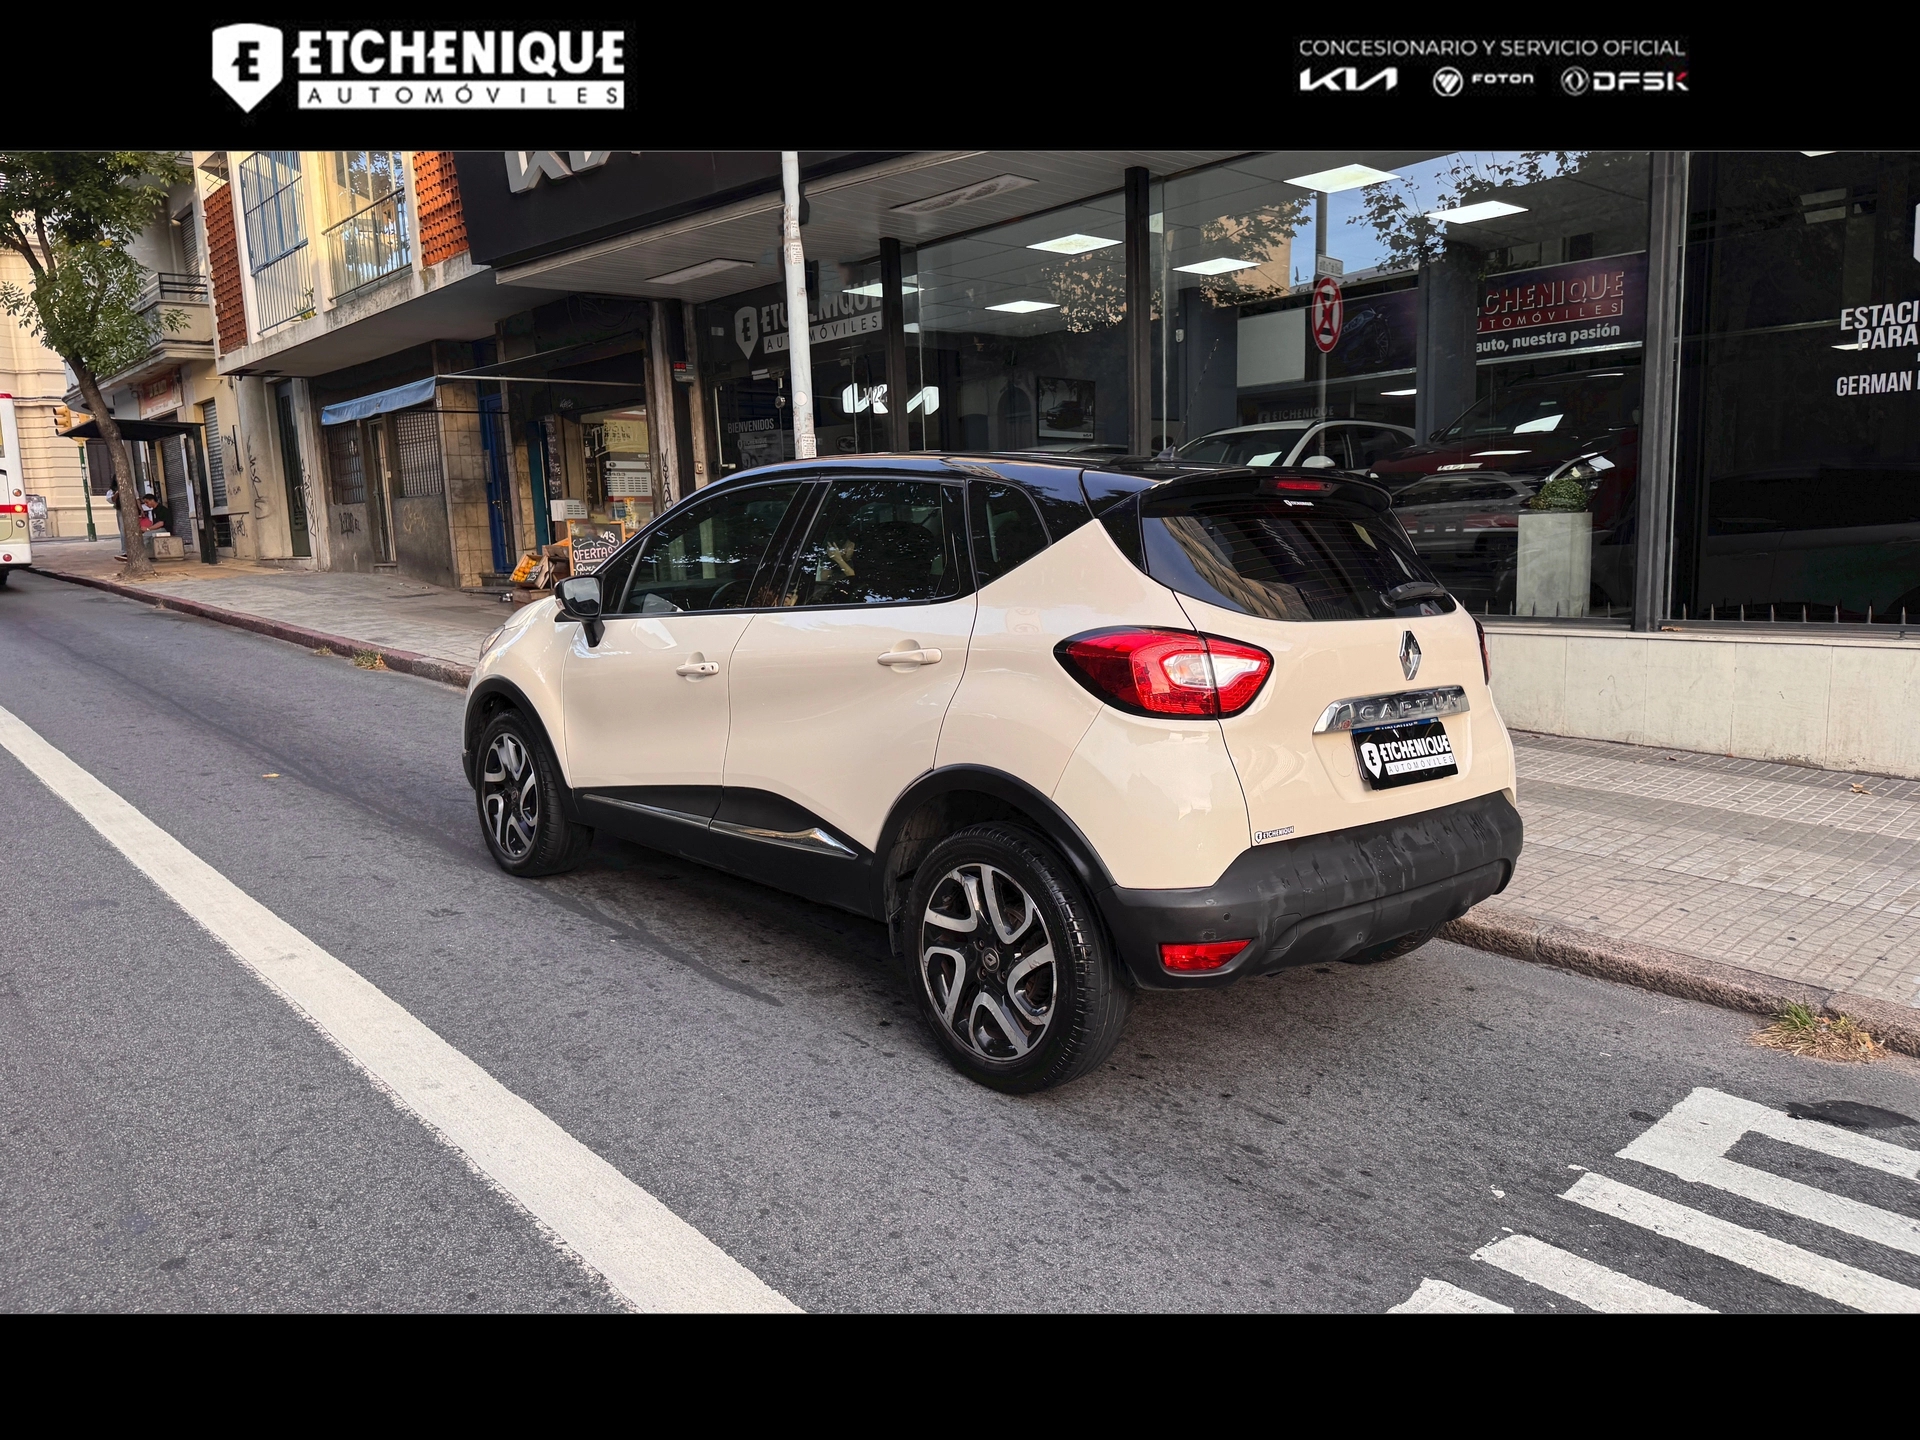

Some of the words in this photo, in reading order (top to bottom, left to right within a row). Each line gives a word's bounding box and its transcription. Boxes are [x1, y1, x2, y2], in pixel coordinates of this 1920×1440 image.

[1476, 271, 1625, 317] CHENIQUE
[1512, 331, 1567, 349] nuestra
[1570, 323, 1621, 345] pasión
[1857, 324, 1919, 351] PARA
[1836, 370, 1913, 397] GERMAN
[727, 417, 775, 434] BIENVENIDOS
[1359, 693, 1458, 721] CAPTUR
[1379, 734, 1452, 763] ETCHENIQUE
